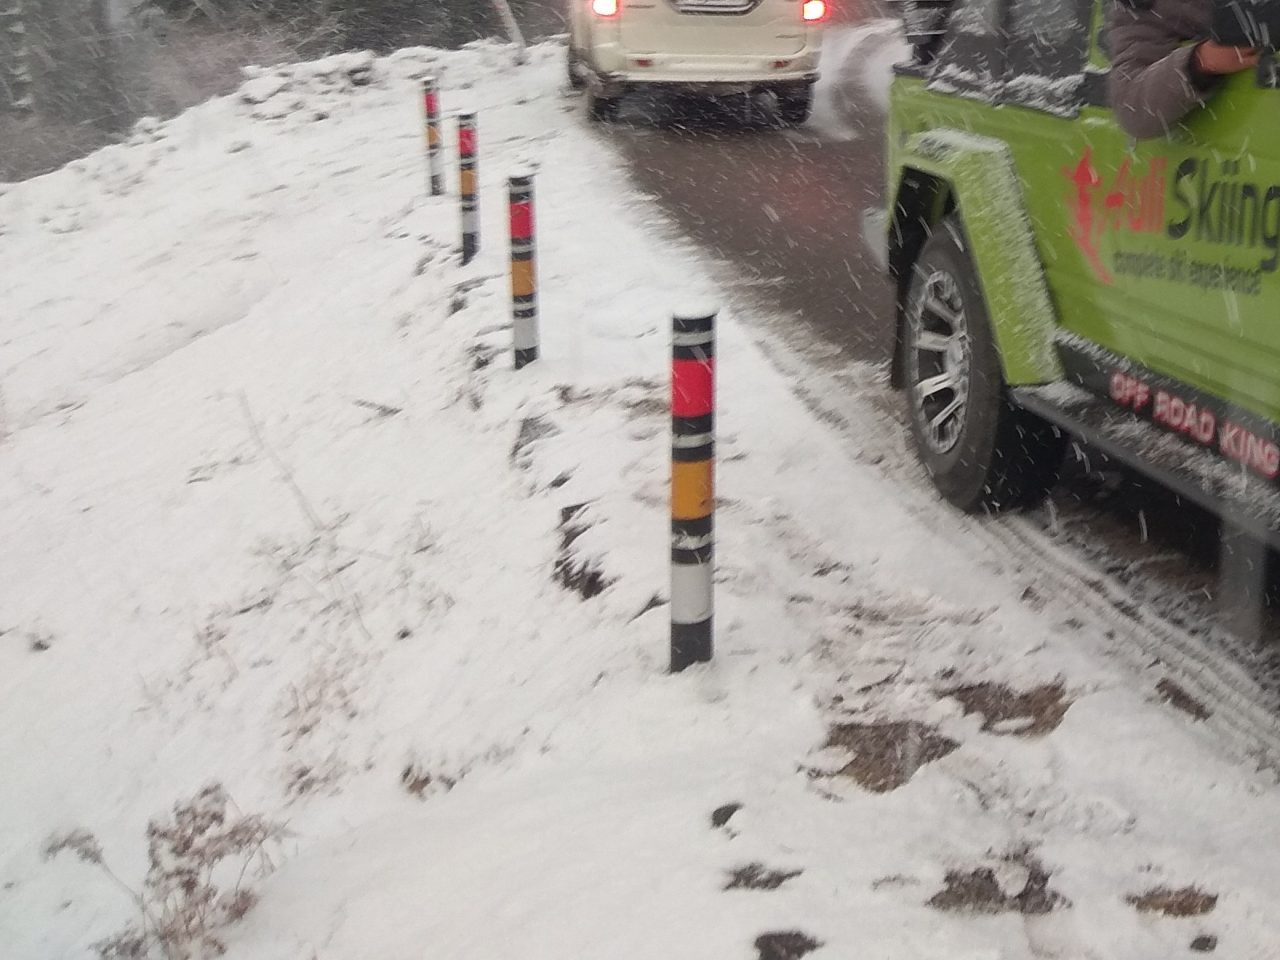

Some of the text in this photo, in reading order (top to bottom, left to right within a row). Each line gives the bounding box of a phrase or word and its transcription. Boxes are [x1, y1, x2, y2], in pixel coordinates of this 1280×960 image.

[1110, 371, 1280, 480] OFF ROAD KING
